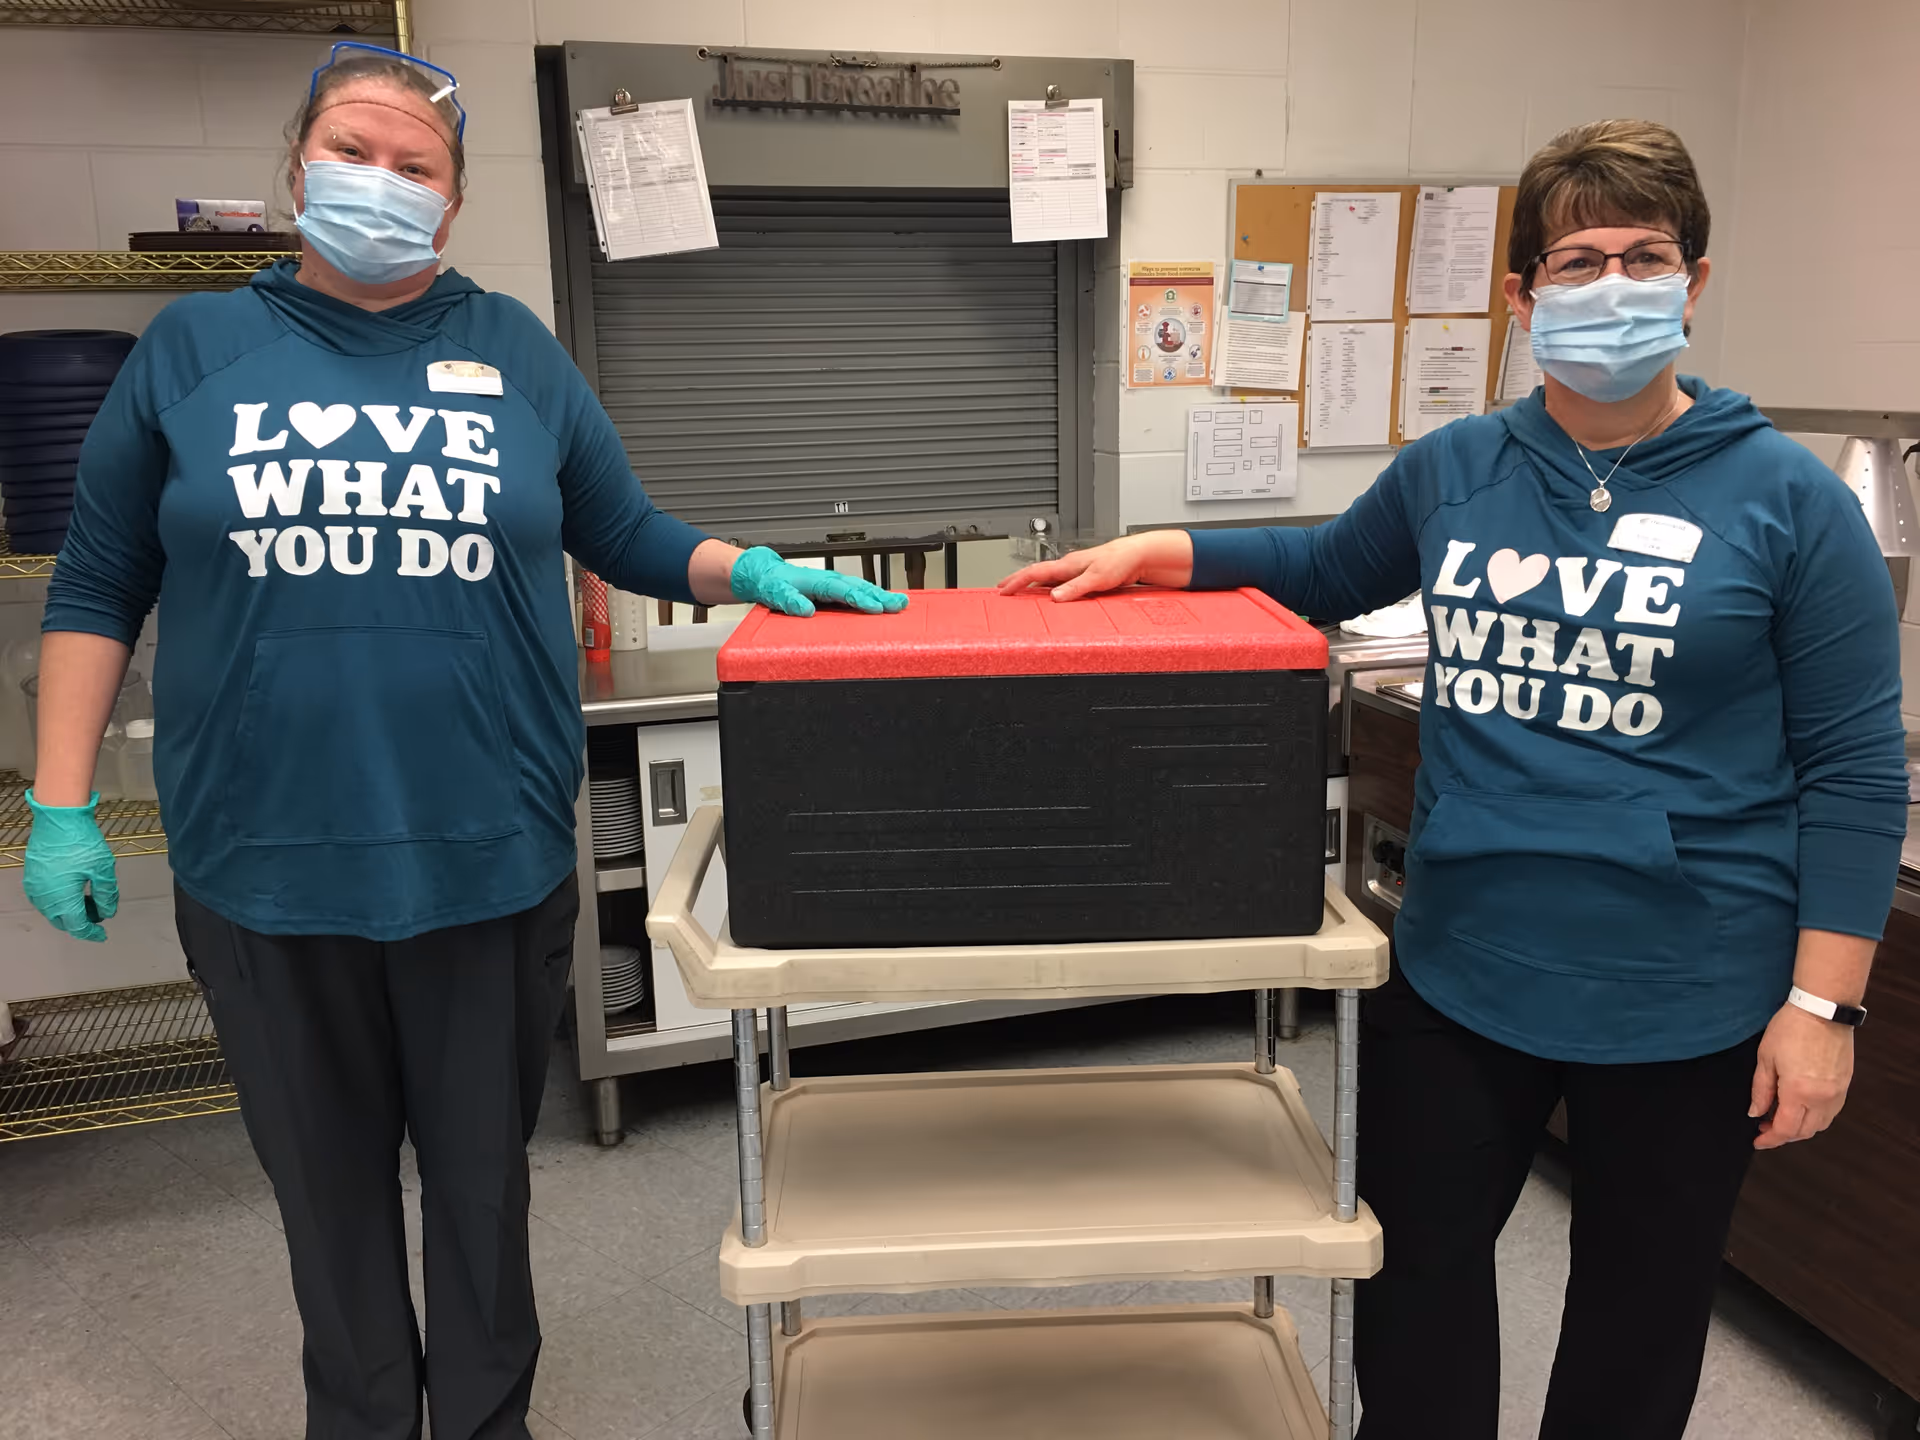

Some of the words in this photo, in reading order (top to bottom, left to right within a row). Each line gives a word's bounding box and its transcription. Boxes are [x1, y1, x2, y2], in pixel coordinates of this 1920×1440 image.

[712, 53, 795, 100] Just
[808, 62, 960, 107] Breathe
[227, 459, 501, 525] WHAT
[229, 525, 378, 578] YOU
[397, 528, 495, 582] DO
[1430, 605, 1675, 687] WHAT
[1434, 662, 1546, 720] YOU
[1557, 683, 1663, 737] DO
